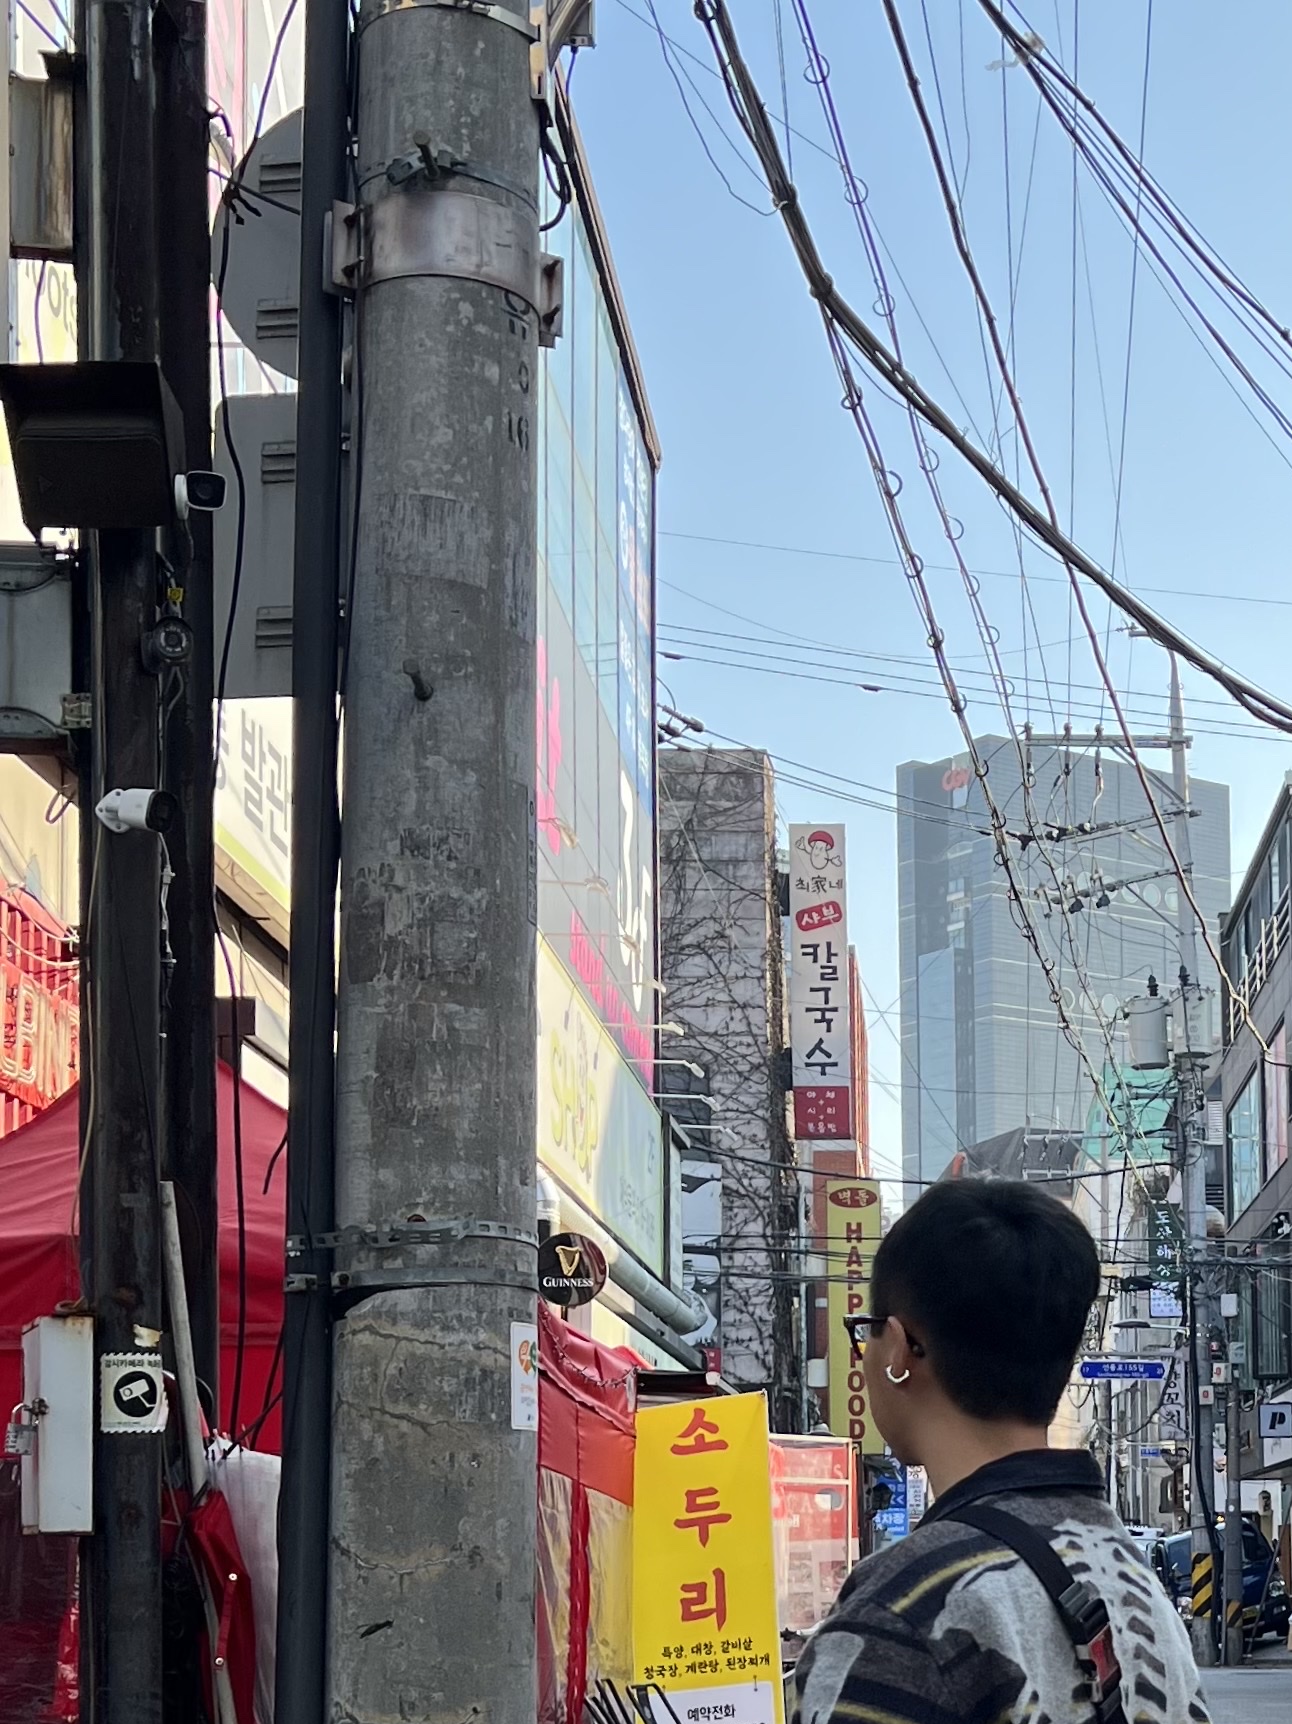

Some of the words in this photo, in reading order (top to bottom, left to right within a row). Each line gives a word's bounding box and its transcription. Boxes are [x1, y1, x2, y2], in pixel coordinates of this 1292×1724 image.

[801, 904, 839, 926] 샤부
[800, 941, 839, 1076] 칼국수
[846, 1222, 864, 1314] HAPP
[542, 1276, 594, 1288] GUINNESS
[1269, 1412, 1286, 1430] P
[671, 1407, 733, 1633] 소두리
[661, 1645, 688, 1659] 특양,
[691, 1641, 717, 1656] 대창,
[720, 1636, 753, 1654] 갈비살
[643, 1663, 682, 1680] 청국장,
[725, 1653, 770, 1671] 된장찌개
[687, 1704, 736, 1722] 예약전화
